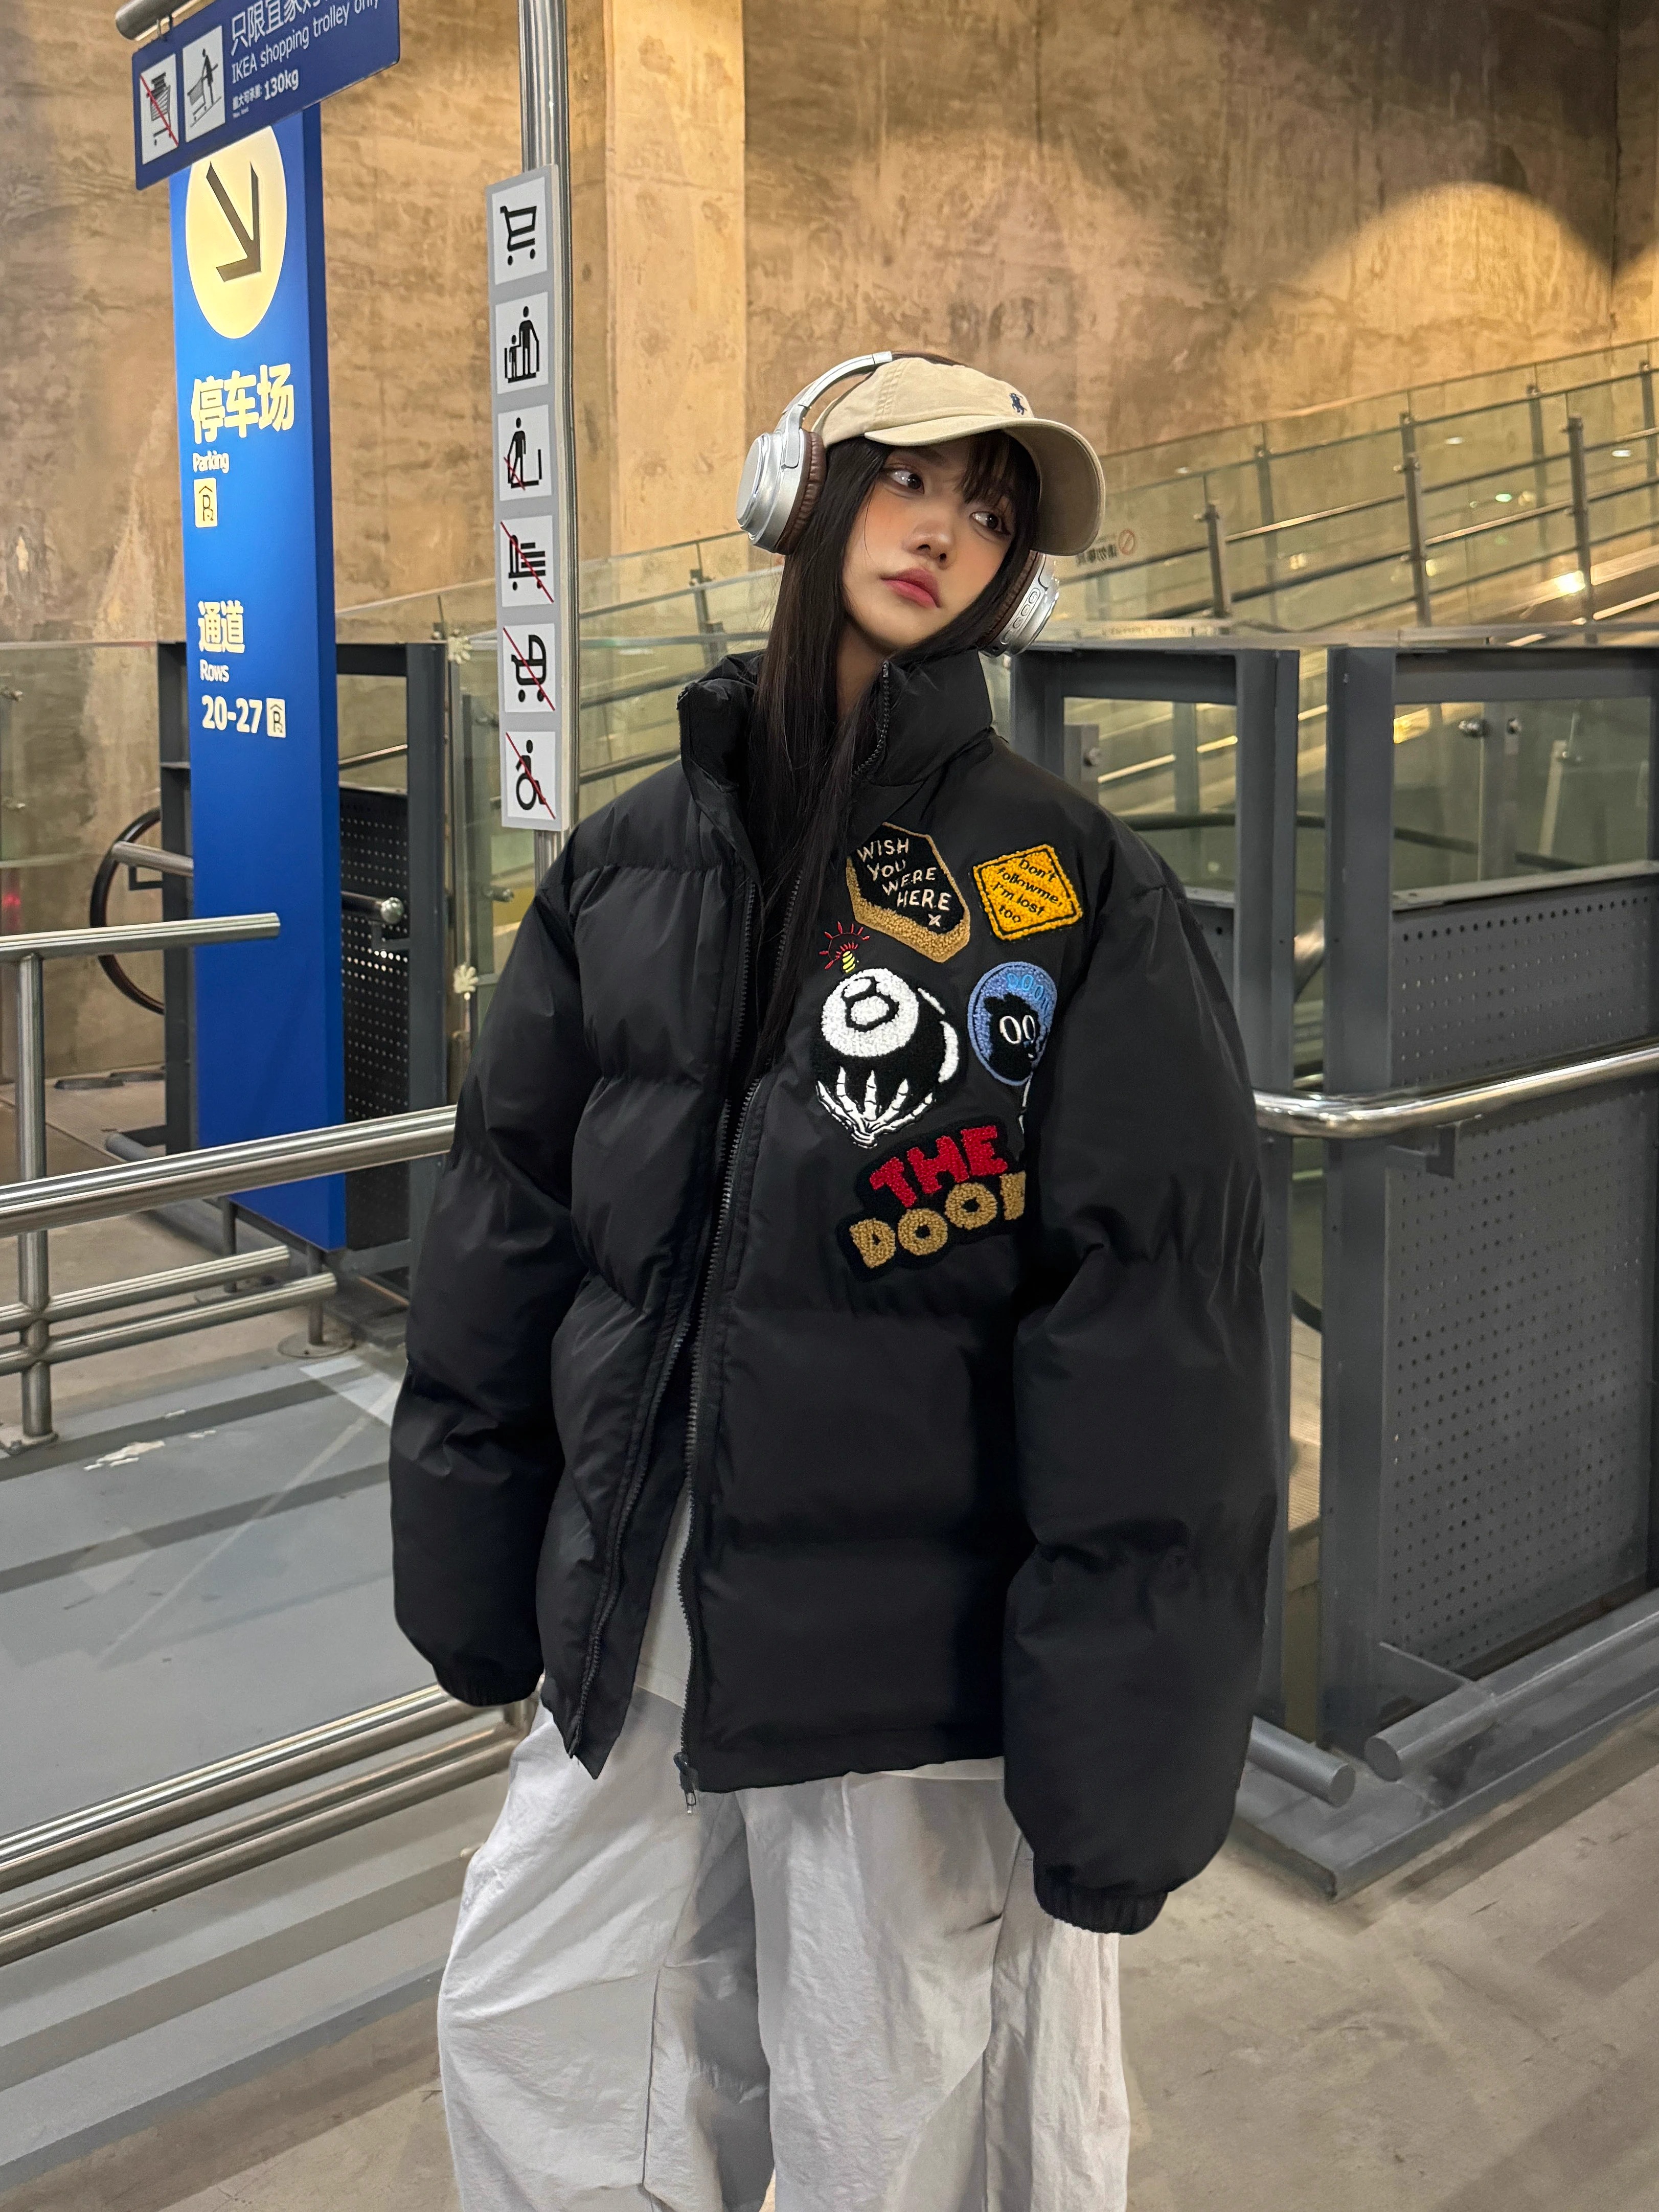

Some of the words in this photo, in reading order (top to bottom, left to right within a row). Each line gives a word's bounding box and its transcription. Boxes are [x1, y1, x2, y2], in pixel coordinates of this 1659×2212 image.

[232, 53, 257, 84] IKEA
[260, 26, 309, 63] shopping
[313, 2, 350, 37] trolley
[264, 69, 299, 101] 130kg
[191, 363, 294, 444] 停车场
[193, 450, 229, 473] Parking
[198, 600, 245, 653] 通道
[200, 659, 229, 682] Rows
[202, 695, 262, 734] 20-27
[857, 838, 909, 862] WISH
[867, 859, 905, 881] YOU
[882, 867, 937, 896] WERE
[1019, 859, 1056, 882] Don't
[897, 889, 951, 911] HERE
[993, 881, 1014, 900] I'm
[1017, 893, 1045, 916] lost
[998, 904, 1021, 923] too
[870, 1126, 1008, 1207] THE
